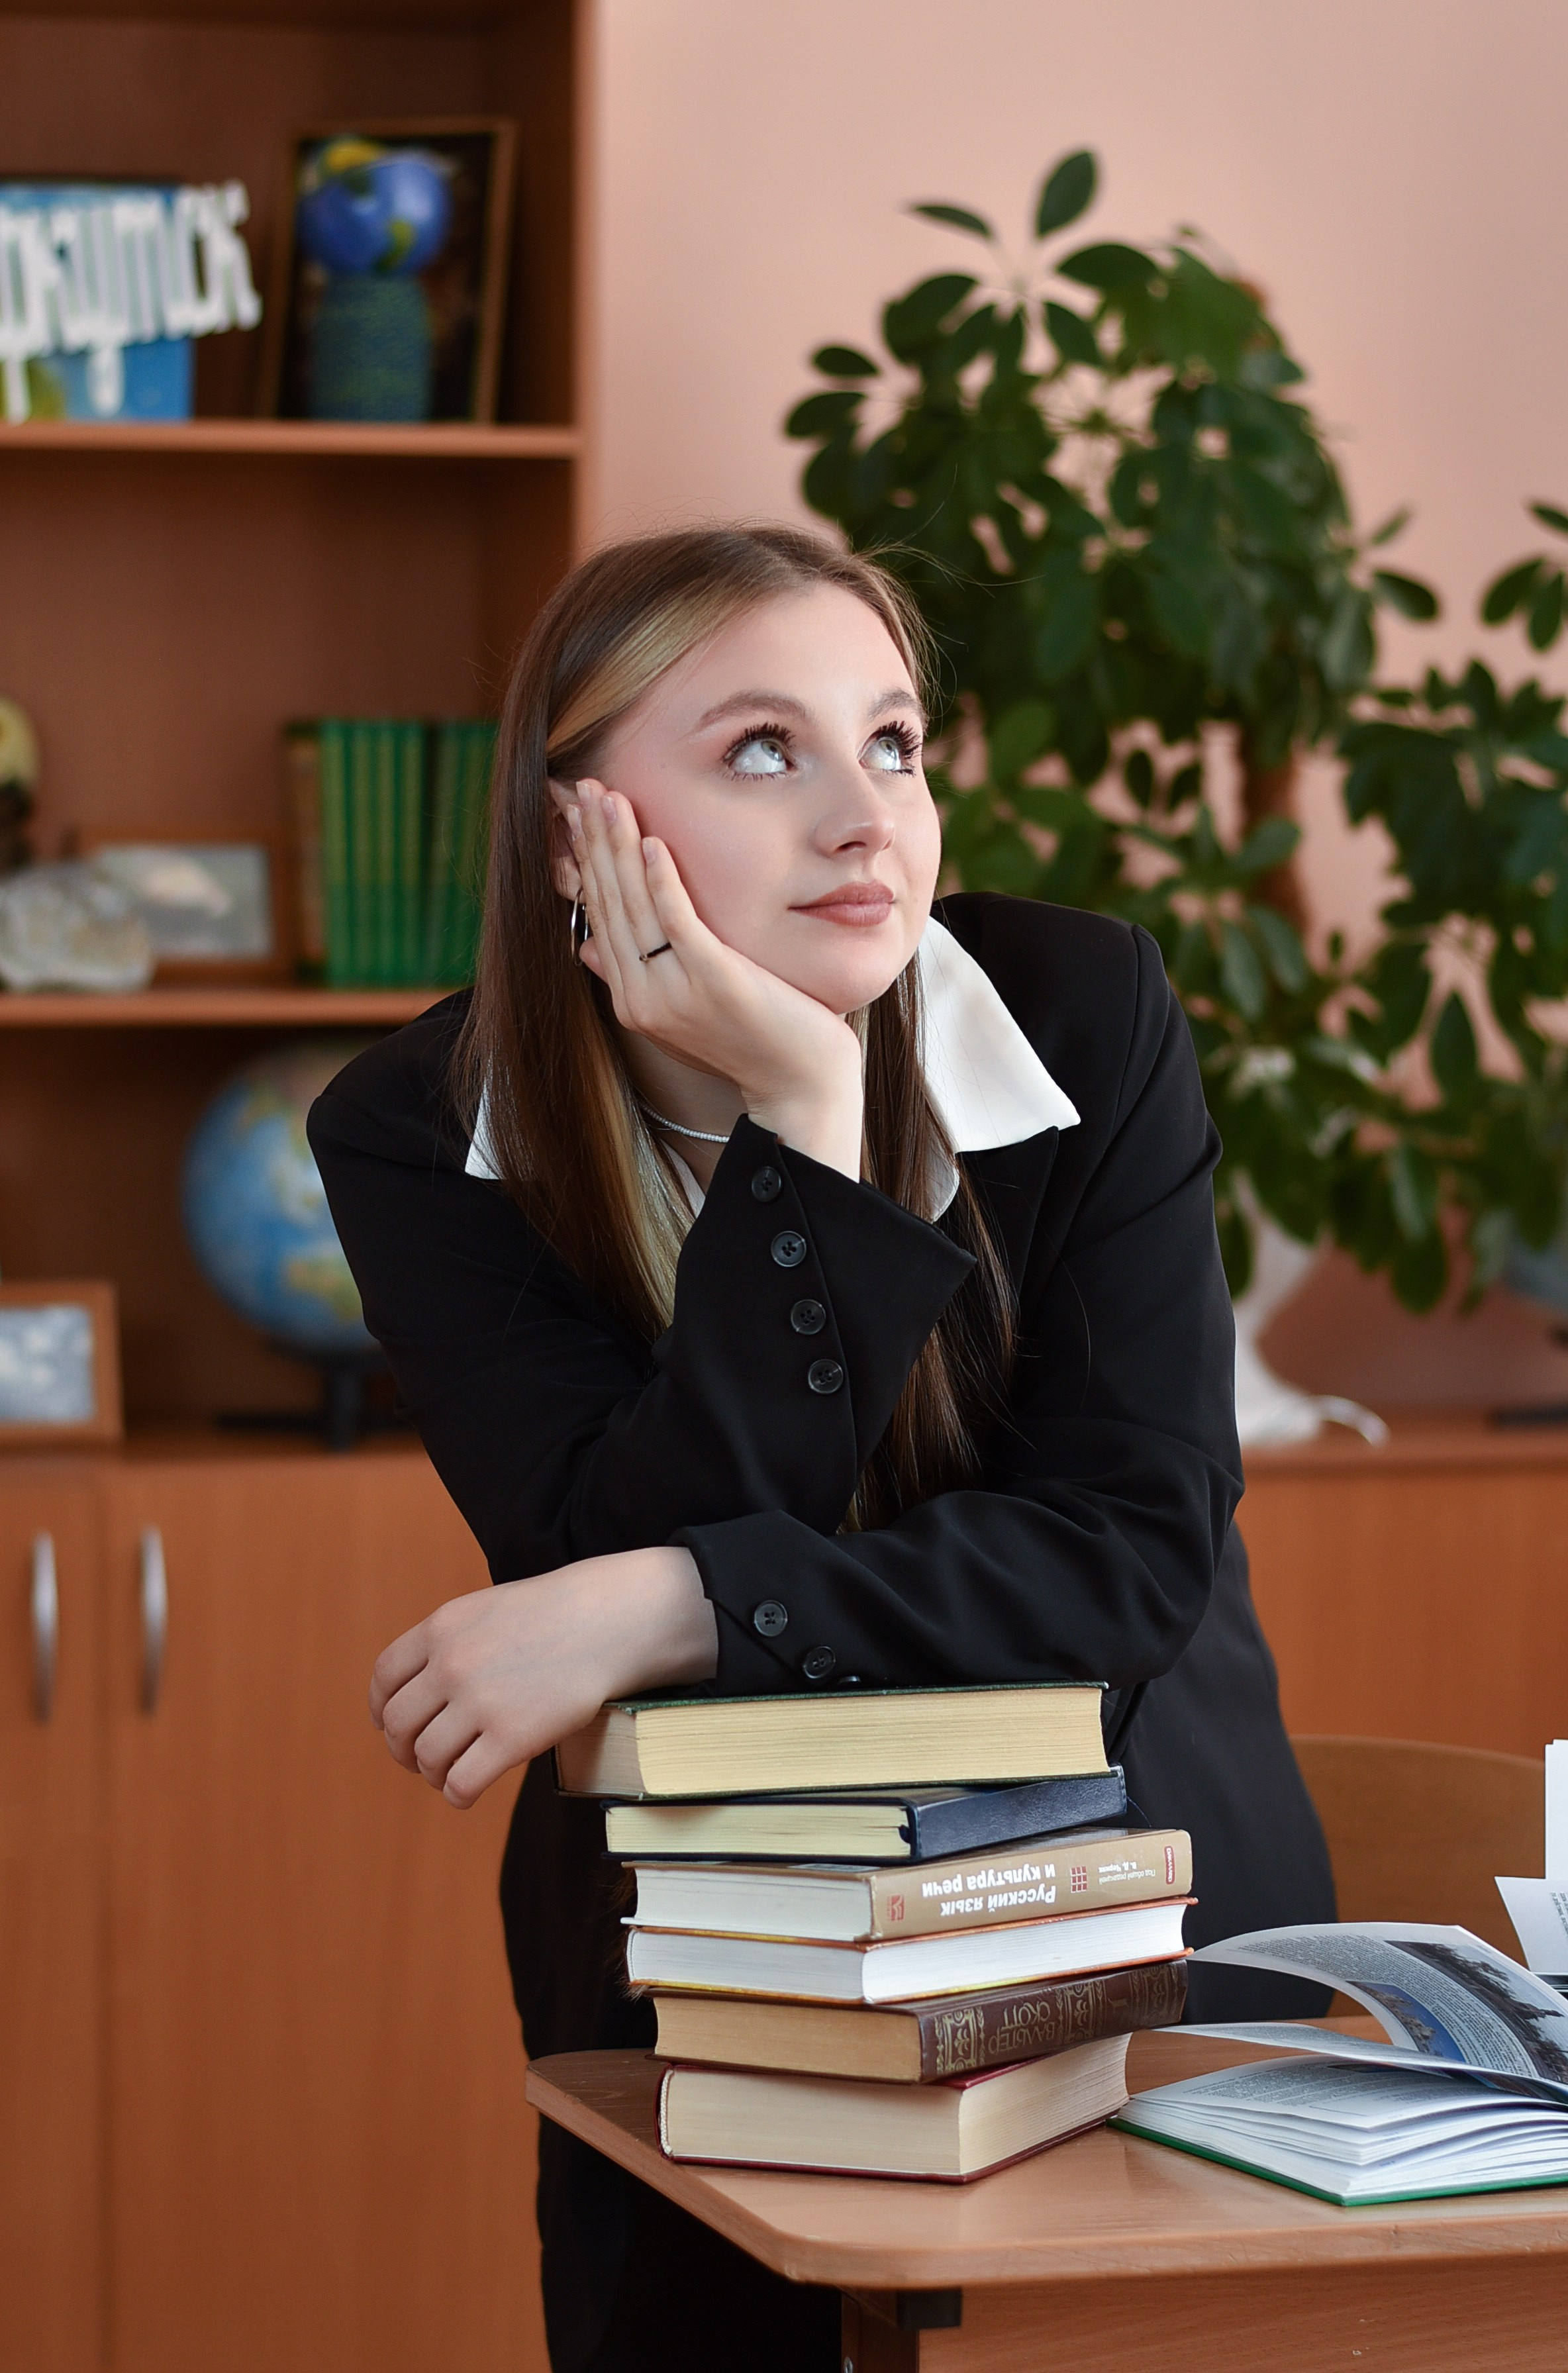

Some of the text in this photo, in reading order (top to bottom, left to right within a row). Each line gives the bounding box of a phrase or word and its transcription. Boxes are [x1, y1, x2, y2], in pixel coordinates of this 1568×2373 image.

[1122, 1861, 1129, 1870] Д.
[1128, 1870, 1144, 1880] общей
[1145, 1868, 1156, 1877] Под
[922, 1863, 1056, 1899] и культура речи
[940, 1884, 1056, 1917] Русский язык
[1001, 2001, 1050, 2030] СКОТТ
[989, 2021, 1055, 2055] ВАЛЬТЕР
